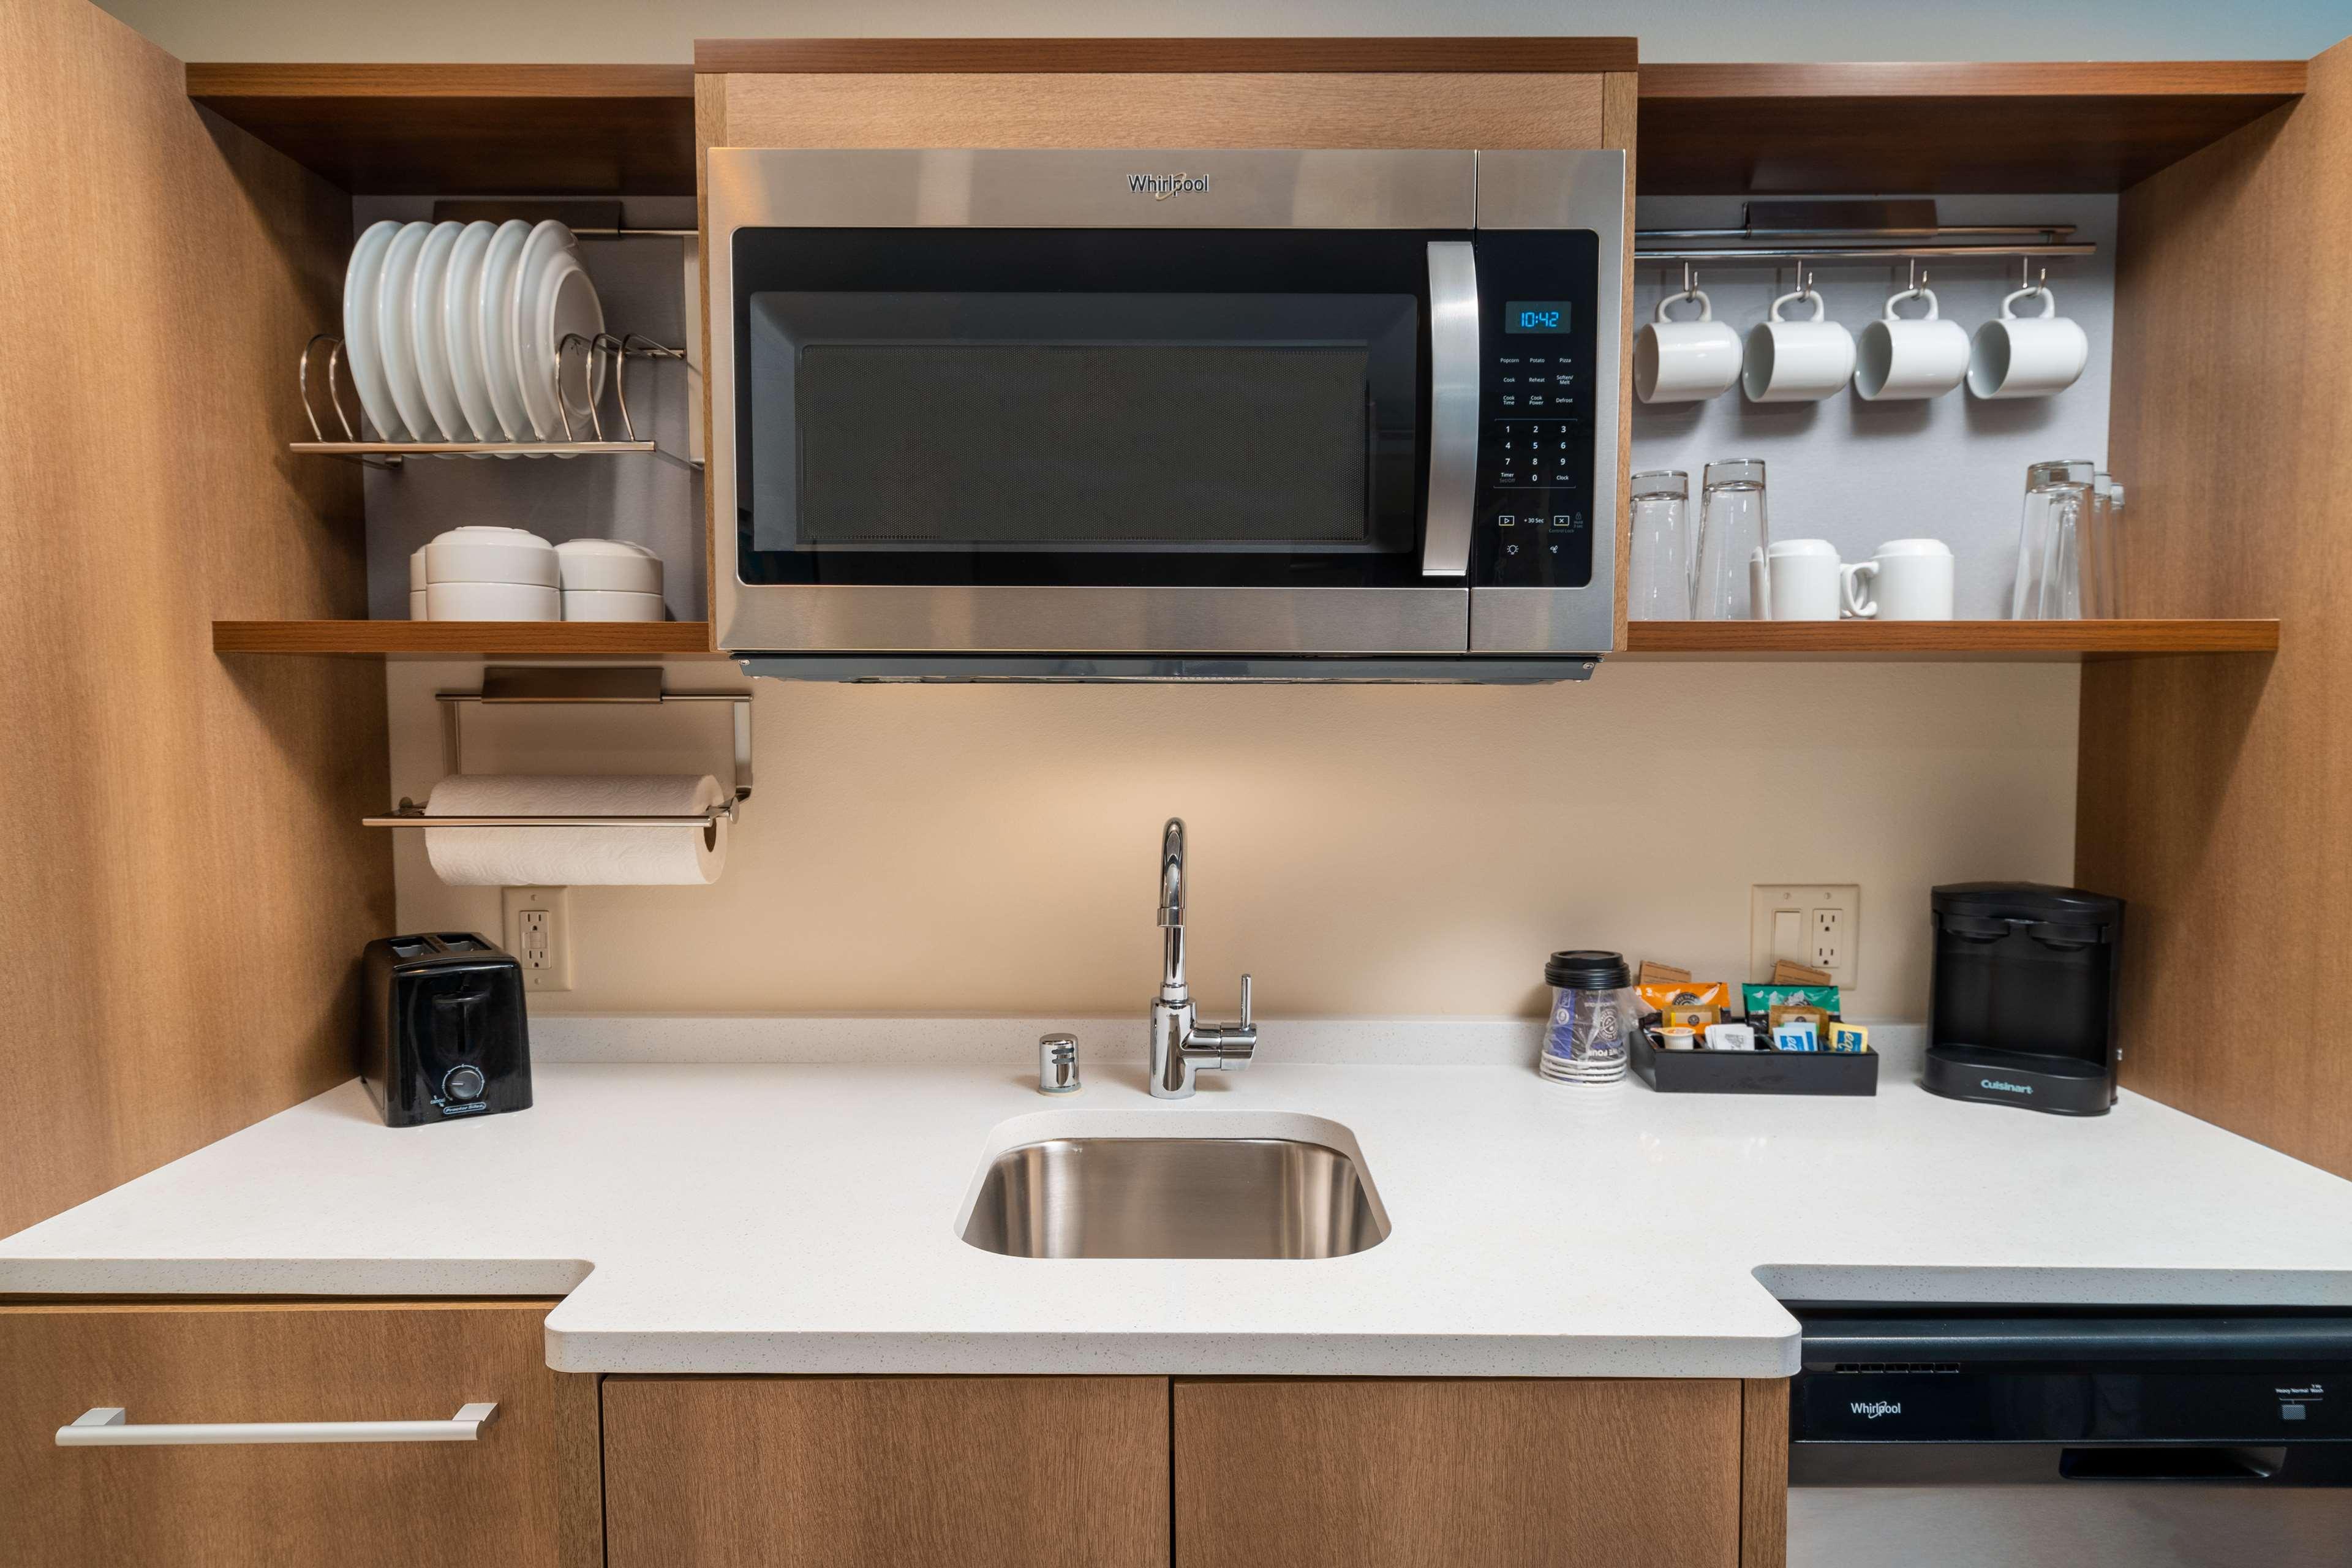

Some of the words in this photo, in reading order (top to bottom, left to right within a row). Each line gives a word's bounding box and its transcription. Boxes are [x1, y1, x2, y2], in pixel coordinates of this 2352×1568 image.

[1127, 172, 1209, 202] Whirlpool
[1520, 312, 1559, 327] 10:42
[1532, 473, 1538, 482] 0
[1980, 1079, 2033, 1095] Cuisinart
[1850, 1401, 1901, 1419] Whirlpool
